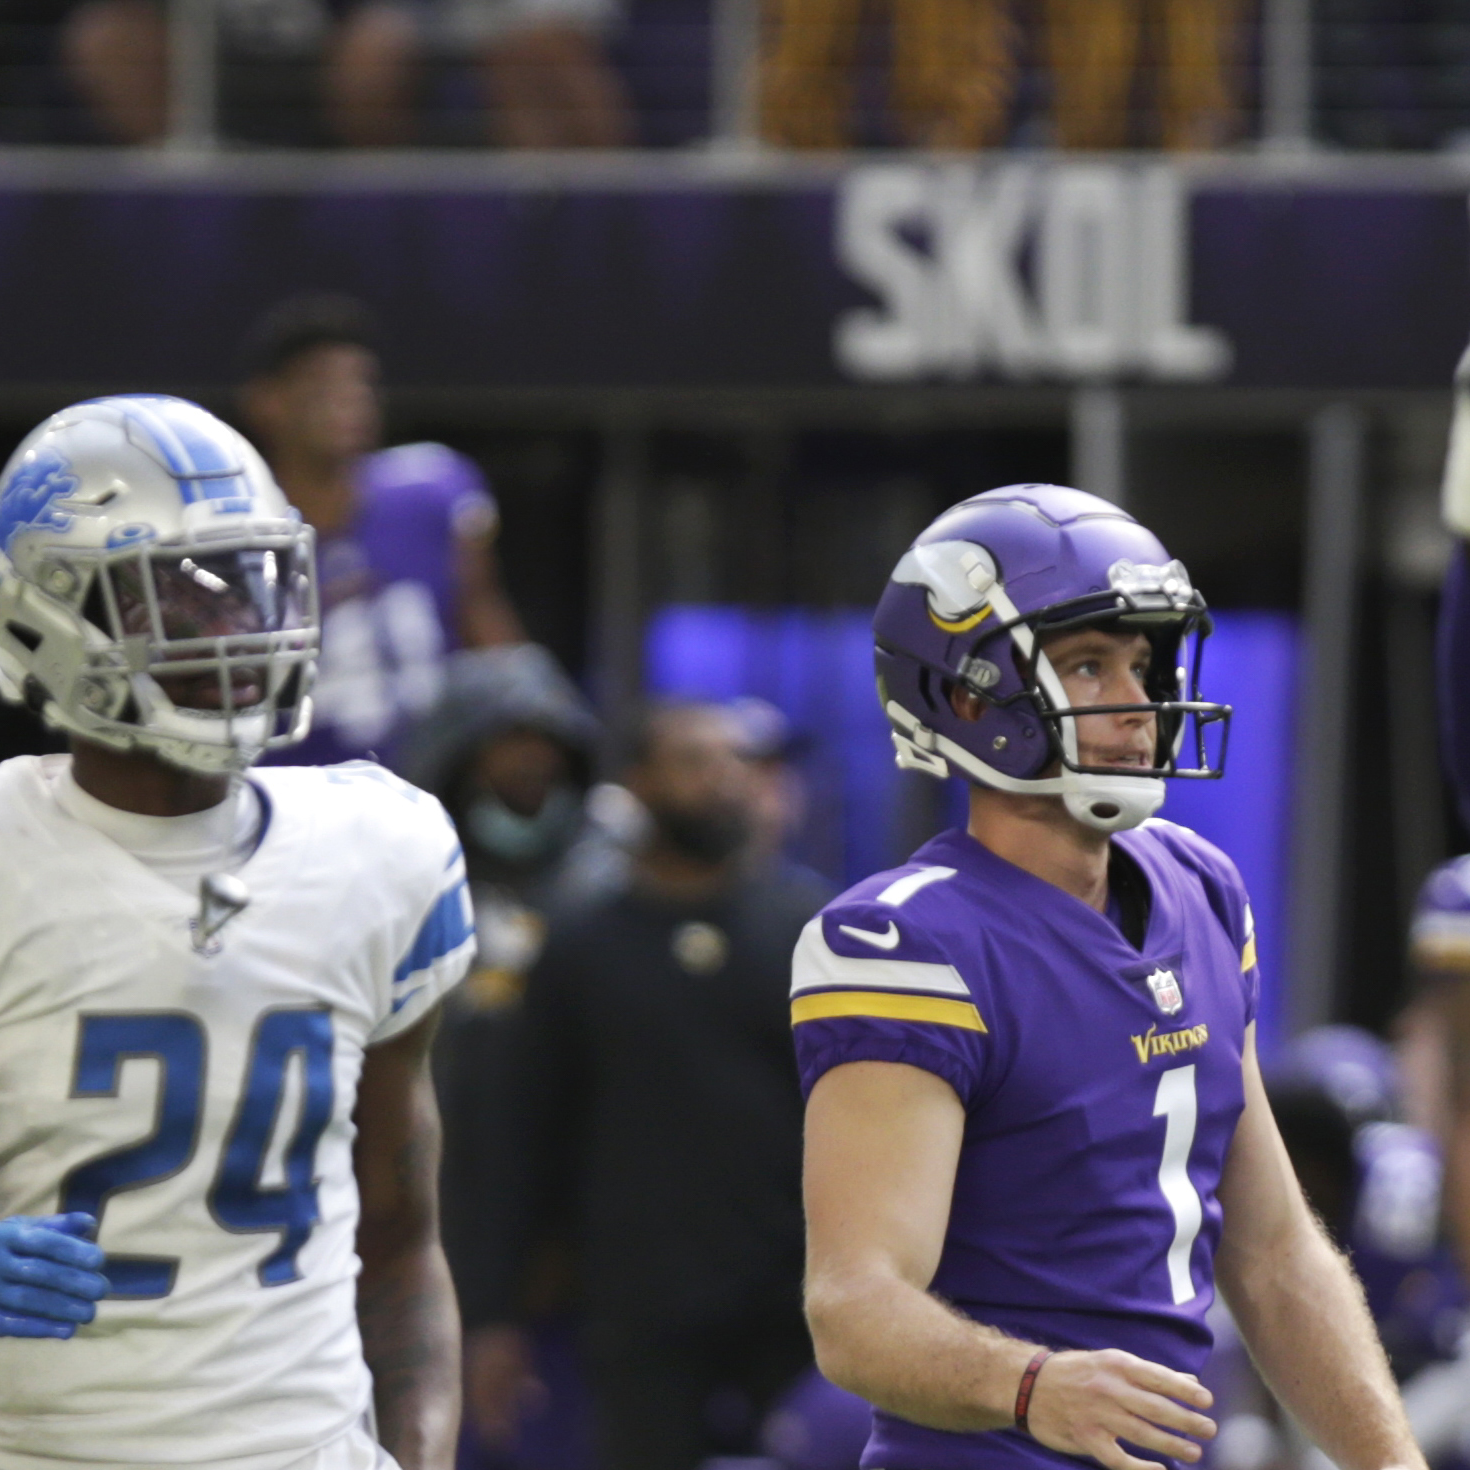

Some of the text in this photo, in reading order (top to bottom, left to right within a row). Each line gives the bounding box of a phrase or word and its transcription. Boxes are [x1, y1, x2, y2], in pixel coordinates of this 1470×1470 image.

[832, 160, 1234, 382] SKOL
[876, 866, 958, 906] 1
[56, 1002, 334, 1300] 24
[1153, 1064, 1203, 1305] 1
